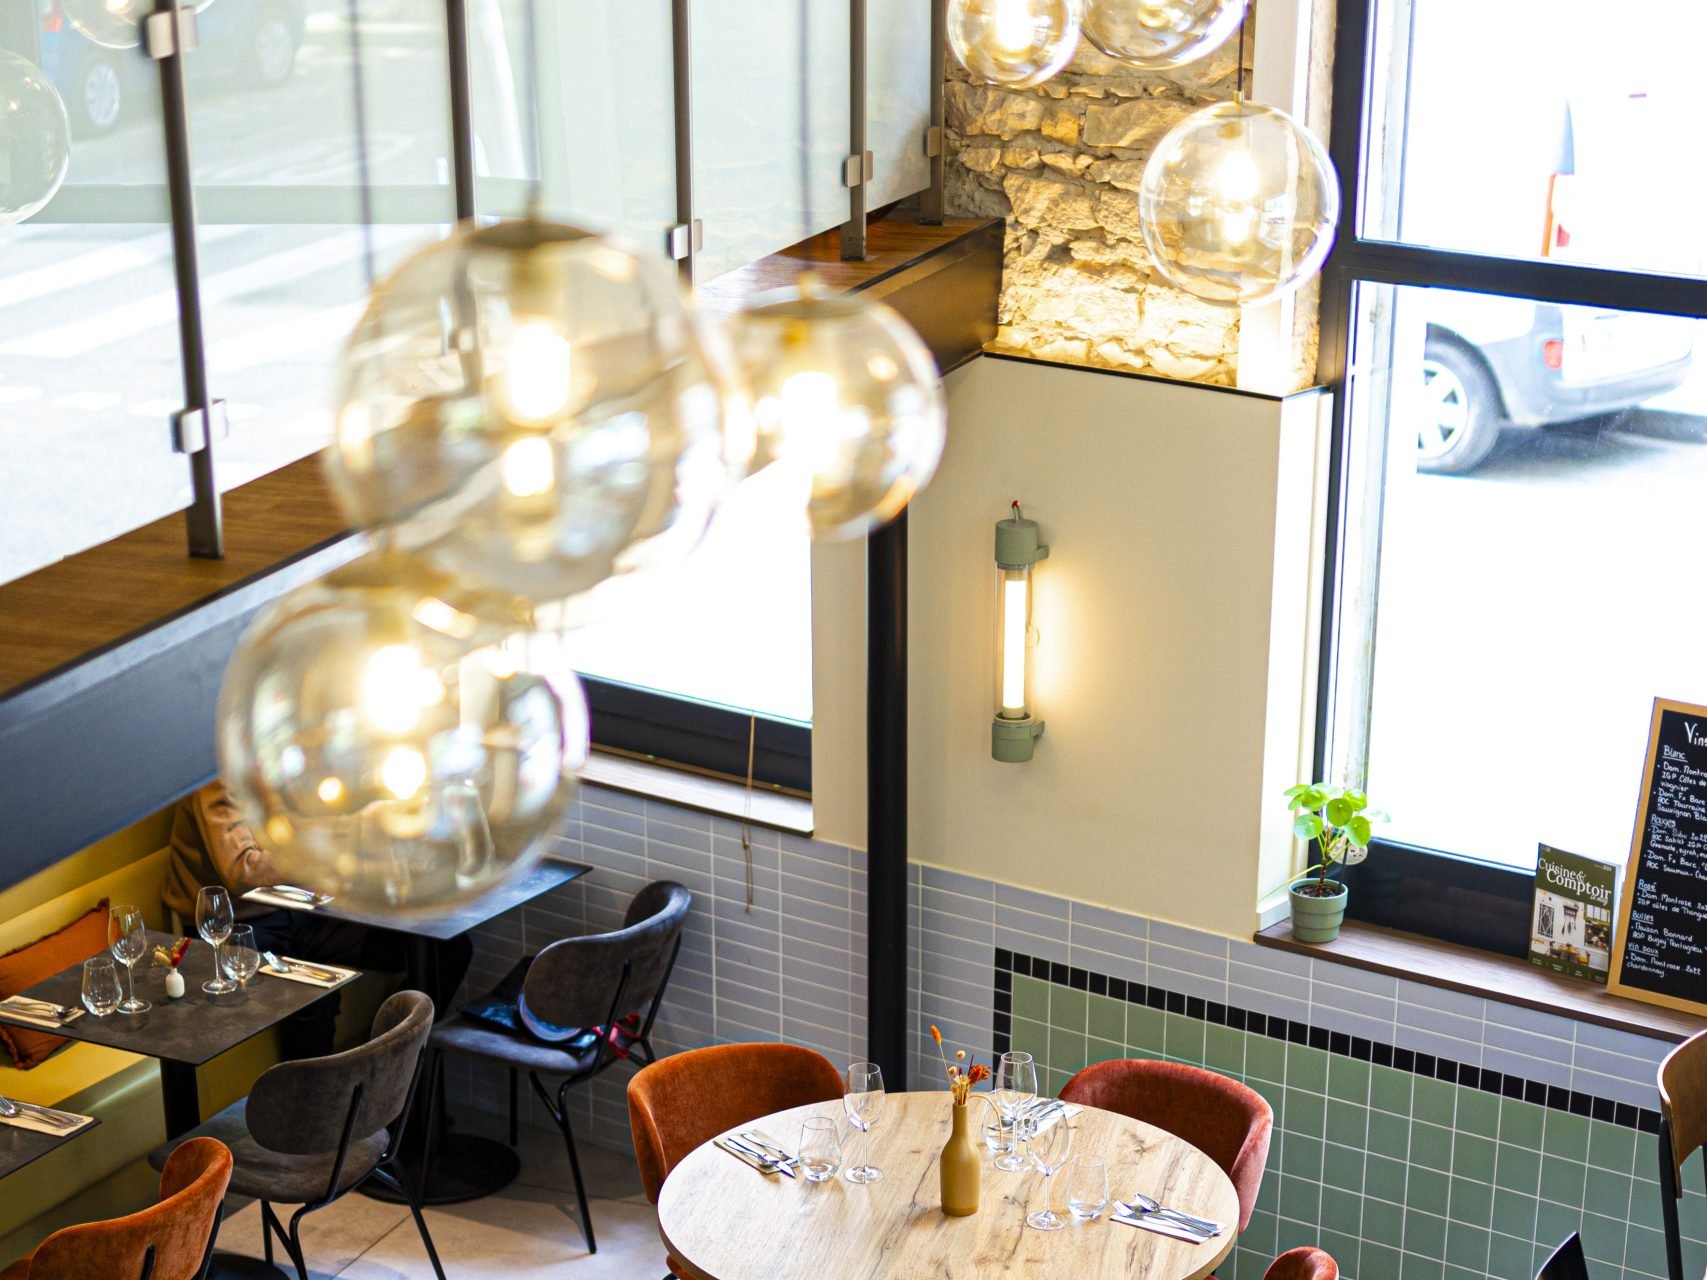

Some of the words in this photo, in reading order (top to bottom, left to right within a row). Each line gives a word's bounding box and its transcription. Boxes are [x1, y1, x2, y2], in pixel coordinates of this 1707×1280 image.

[1664, 745, 1685, 759] Blanc
[1662, 771, 1677, 780] IGP
[1547, 869, 1612, 900] Comptoir
[1638, 879, 1657, 889] Rosé
[1632, 910, 1654, 922] Bulles
[1663, 928, 1692, 942] Bonnard
